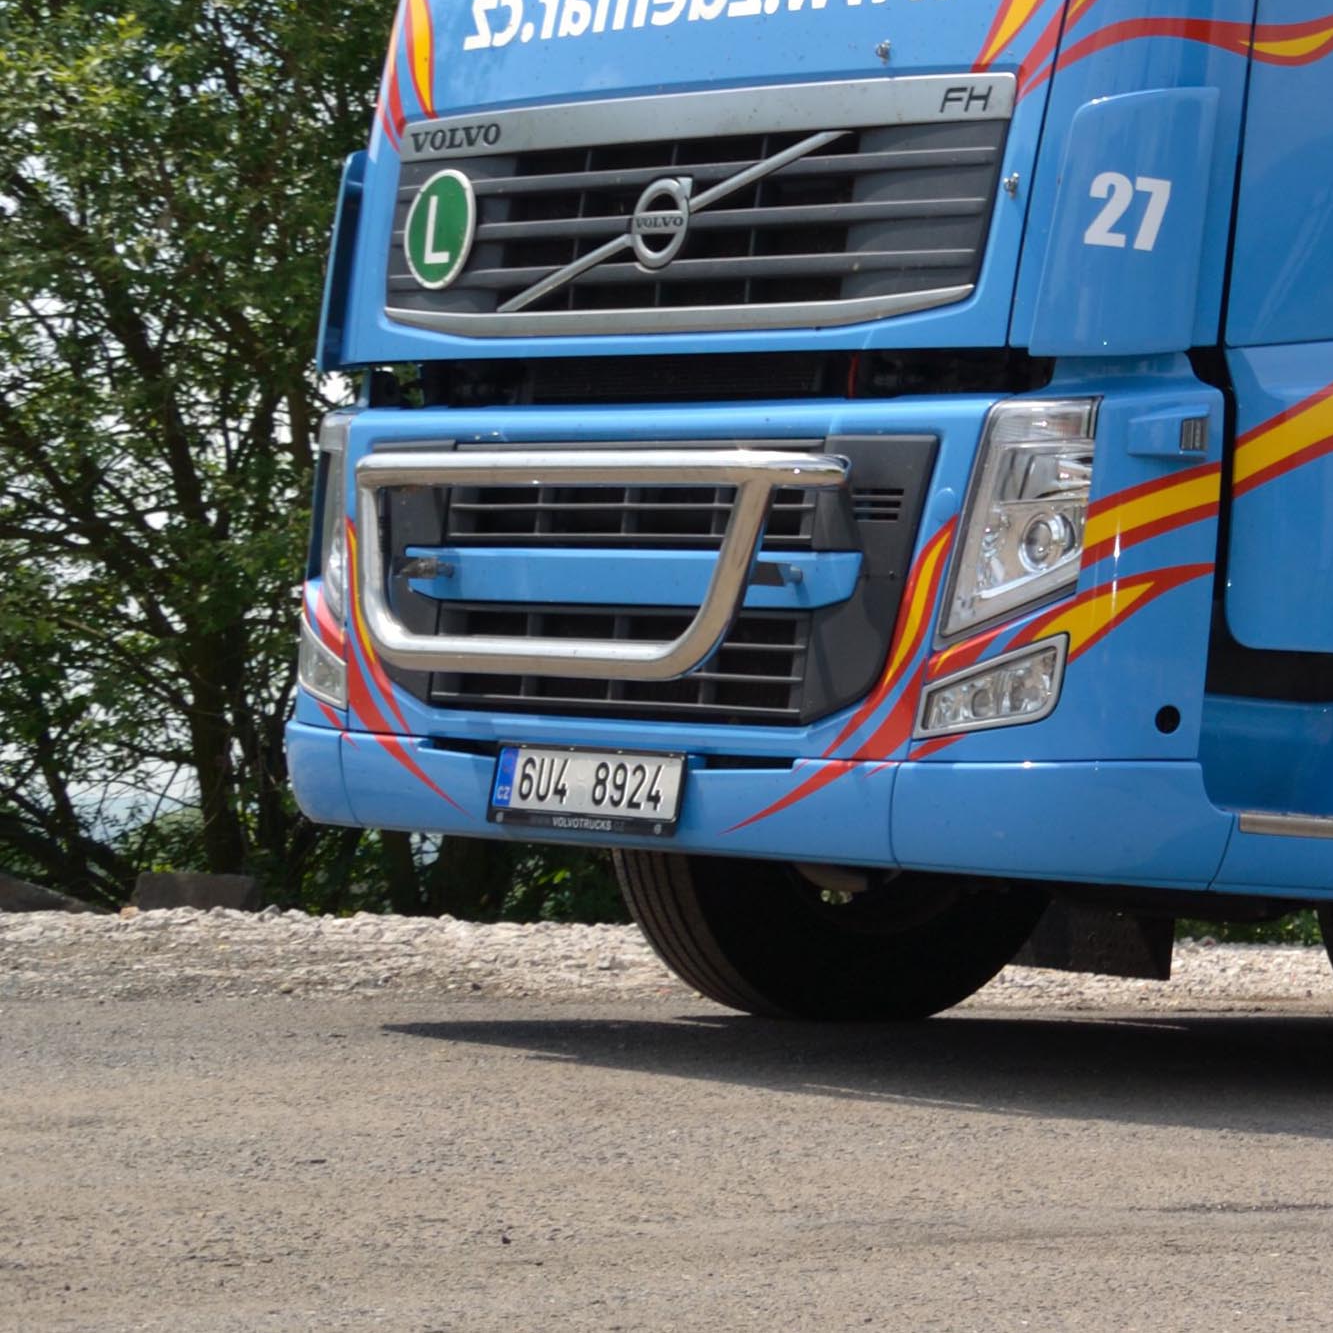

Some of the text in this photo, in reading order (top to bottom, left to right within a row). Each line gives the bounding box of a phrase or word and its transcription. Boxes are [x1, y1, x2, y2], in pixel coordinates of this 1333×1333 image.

[940, 85, 993, 113] FH
[411, 123, 501, 153] VOLVO
[636, 217, 684, 228] VOLVO
[1084, 171, 1172, 252] 27
[424, 195, 450, 264] L
[497, 785, 510, 800] CZ
[518, 755, 664, 812] 6U4 8924
